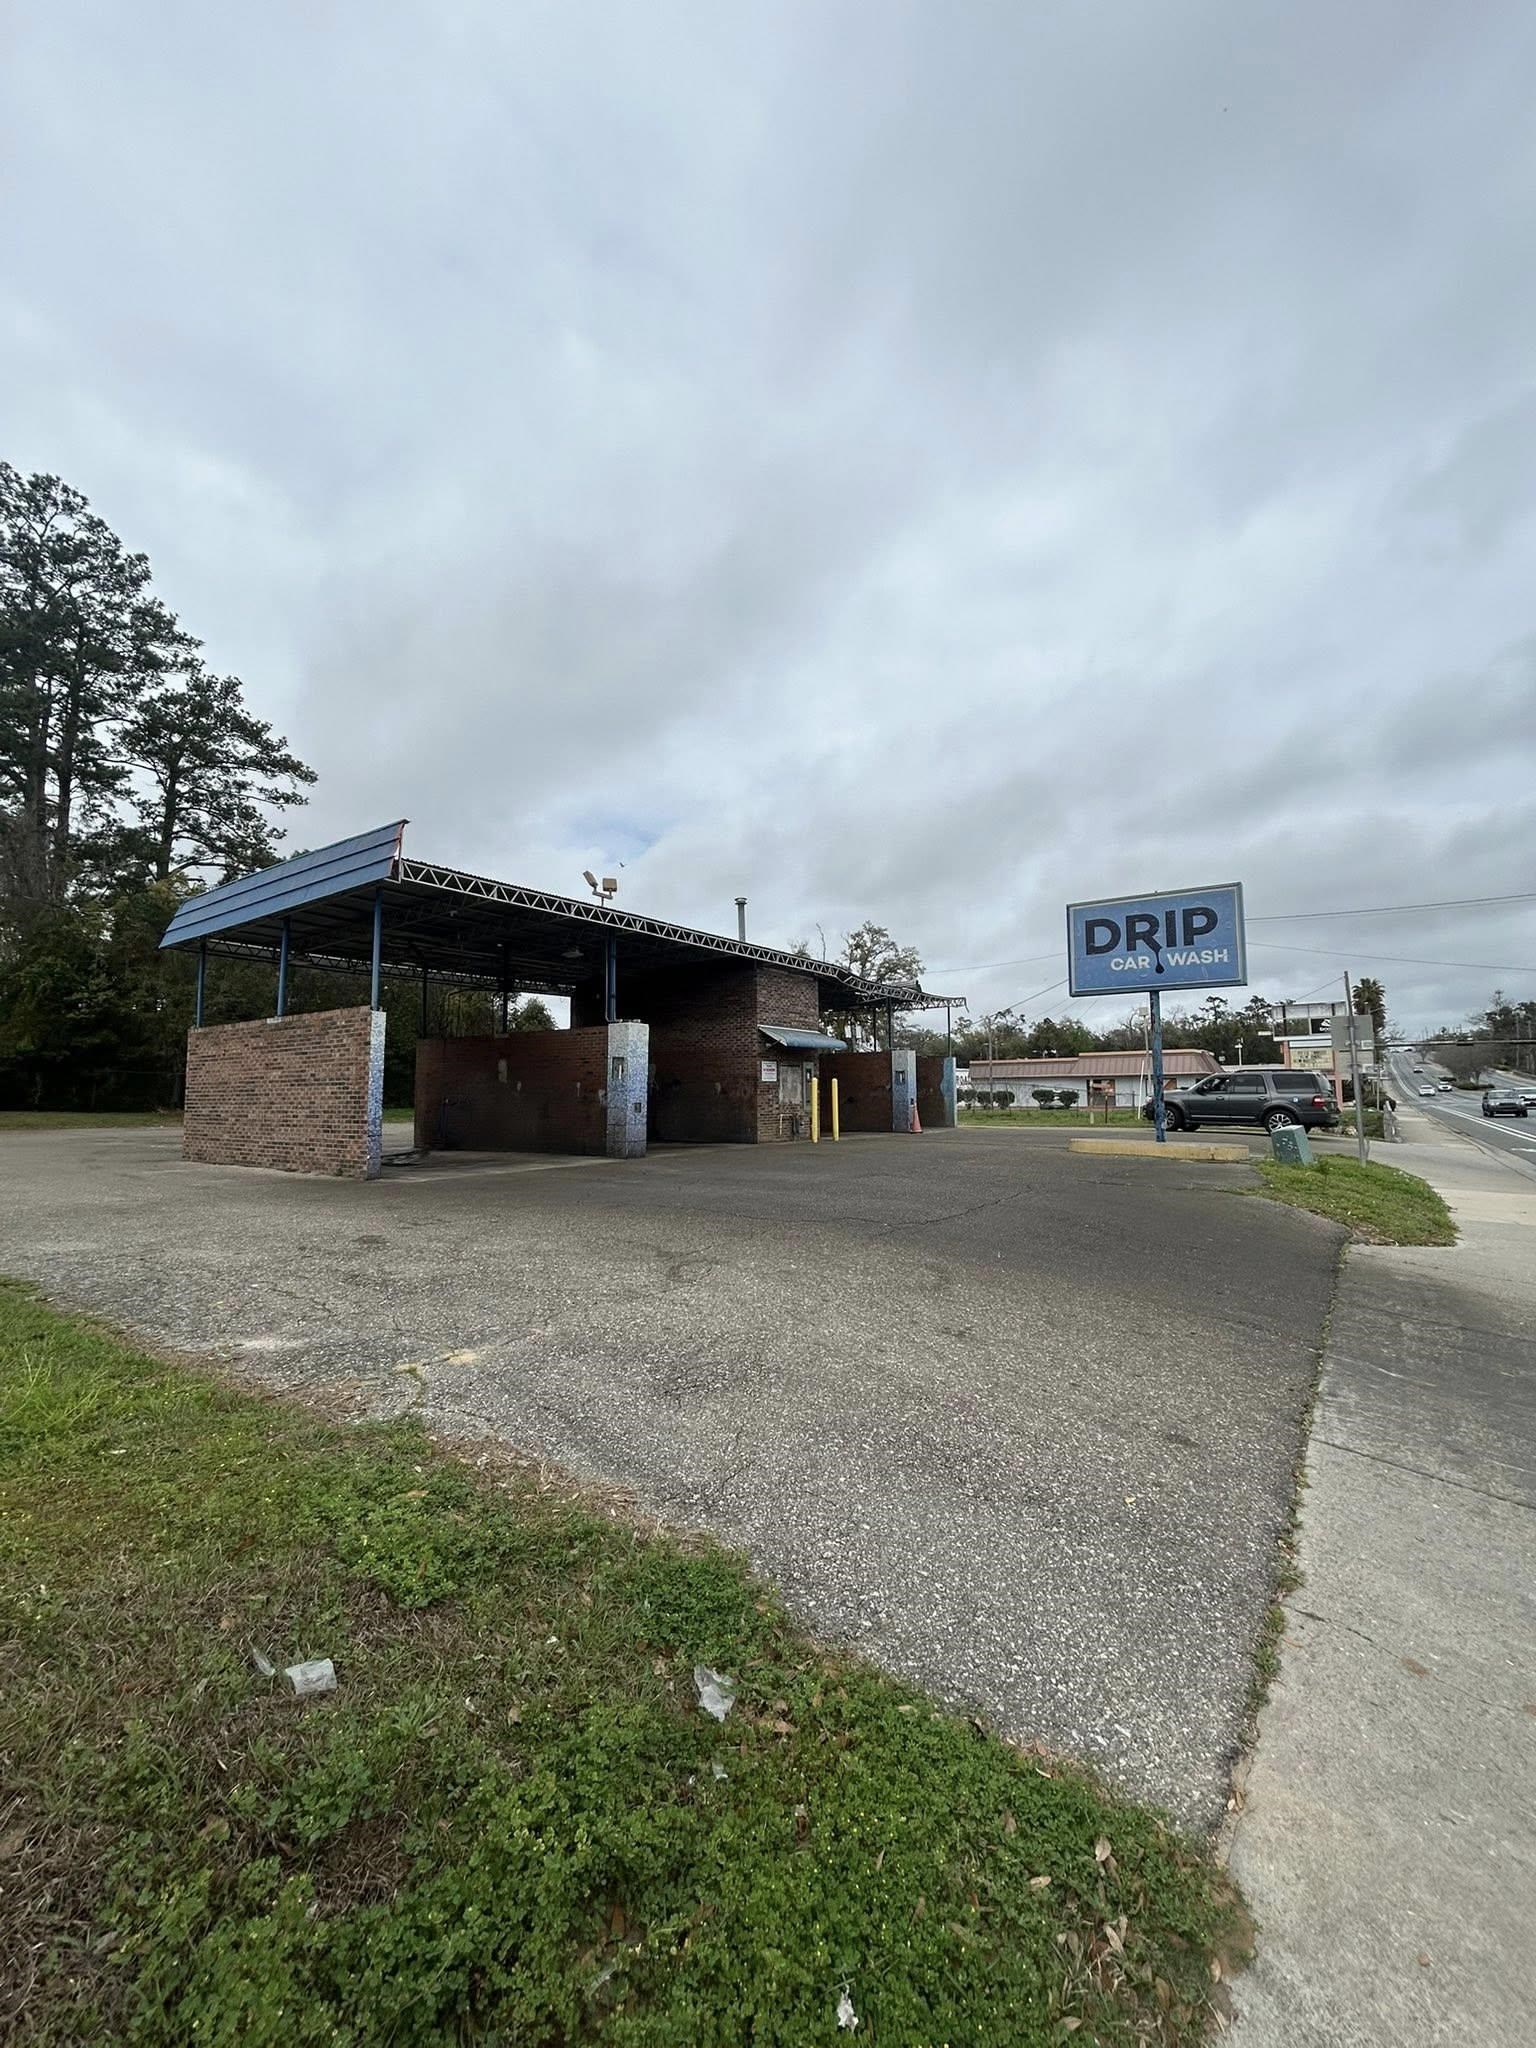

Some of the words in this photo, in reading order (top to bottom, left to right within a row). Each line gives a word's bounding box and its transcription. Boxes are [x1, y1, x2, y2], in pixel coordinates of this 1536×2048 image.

[1085, 906, 1219, 956] DRIP
[1110, 955, 1150, 971] CAR
[1167, 948, 1229, 966] WASH
